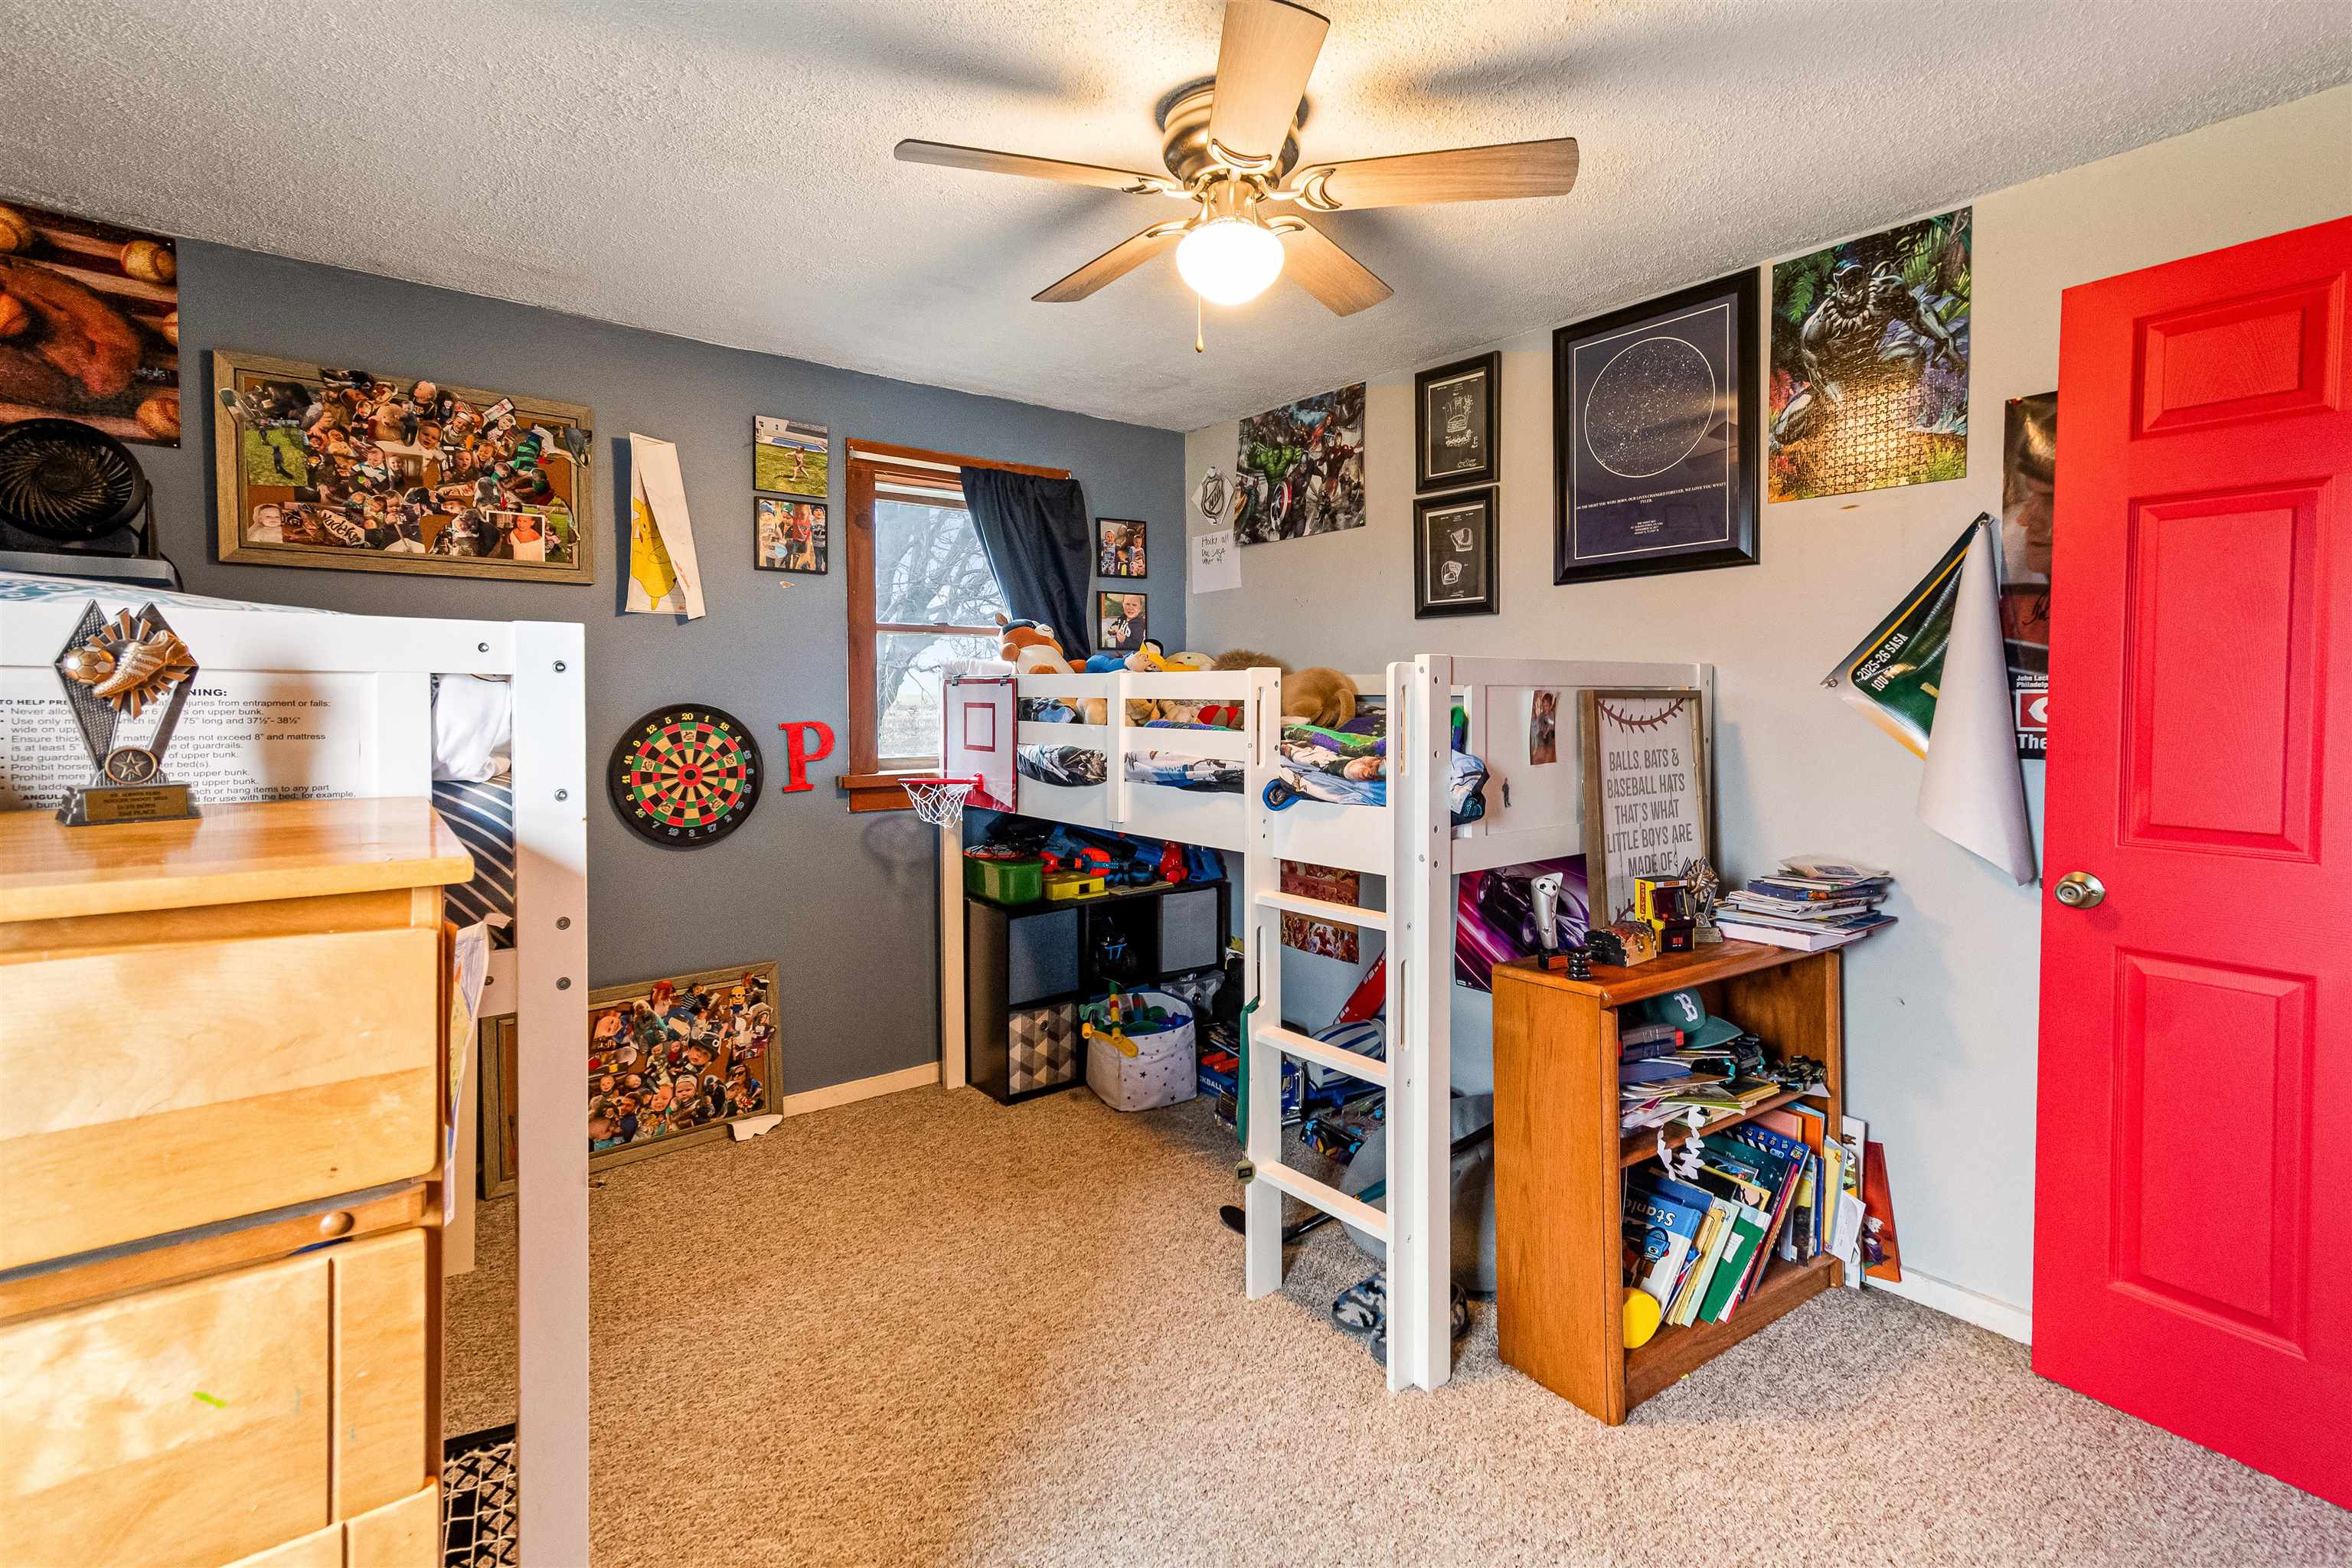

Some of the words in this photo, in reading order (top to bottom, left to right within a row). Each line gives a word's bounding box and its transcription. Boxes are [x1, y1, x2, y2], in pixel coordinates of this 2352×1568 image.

[1857, 649, 1891, 681] 2025-26
[1884, 633, 1909, 653] SASA
[243, 700, 296, 708] entrapment
[38, 717, 60, 726] only
[202, 717, 223, 725] long
[646, 724, 658, 734] 12
[720, 722, 730, 731] 18
[191, 742, 243, 750] guardrails.
[623, 755, 634, 765] 14
[778, 721, 835, 792] P
[1609, 750, 1642, 772] BALLS,
[1644, 748, 1669, 769] BATS
[1671, 747, 1680, 766] &
[11, 763, 54, 772] Prohibit
[57, 763, 95, 772] horsep
[11, 773, 54, 781] Prohibit
[233, 777, 259, 786] bunk.
[622, 775, 631, 784] 11
[227, 786, 251, 795] hang
[1607, 775, 1657, 799] BASEBALL
[1659, 773, 1685, 794] HATS
[626, 793, 635, 802] 8
[1614, 803, 1648, 825] THAT'S
[1651, 799, 1680, 821] WHAT
[652, 820, 661, 829] 7
[1607, 830, 1640, 854] LITTLE
[1642, 826, 1668, 848] BOYS
[1671, 823, 1694, 844] ARE
[1628, 853, 1658, 877] MADE
[1660, 851, 1673, 871] OF
[1673, 993, 1698, 1022] B
